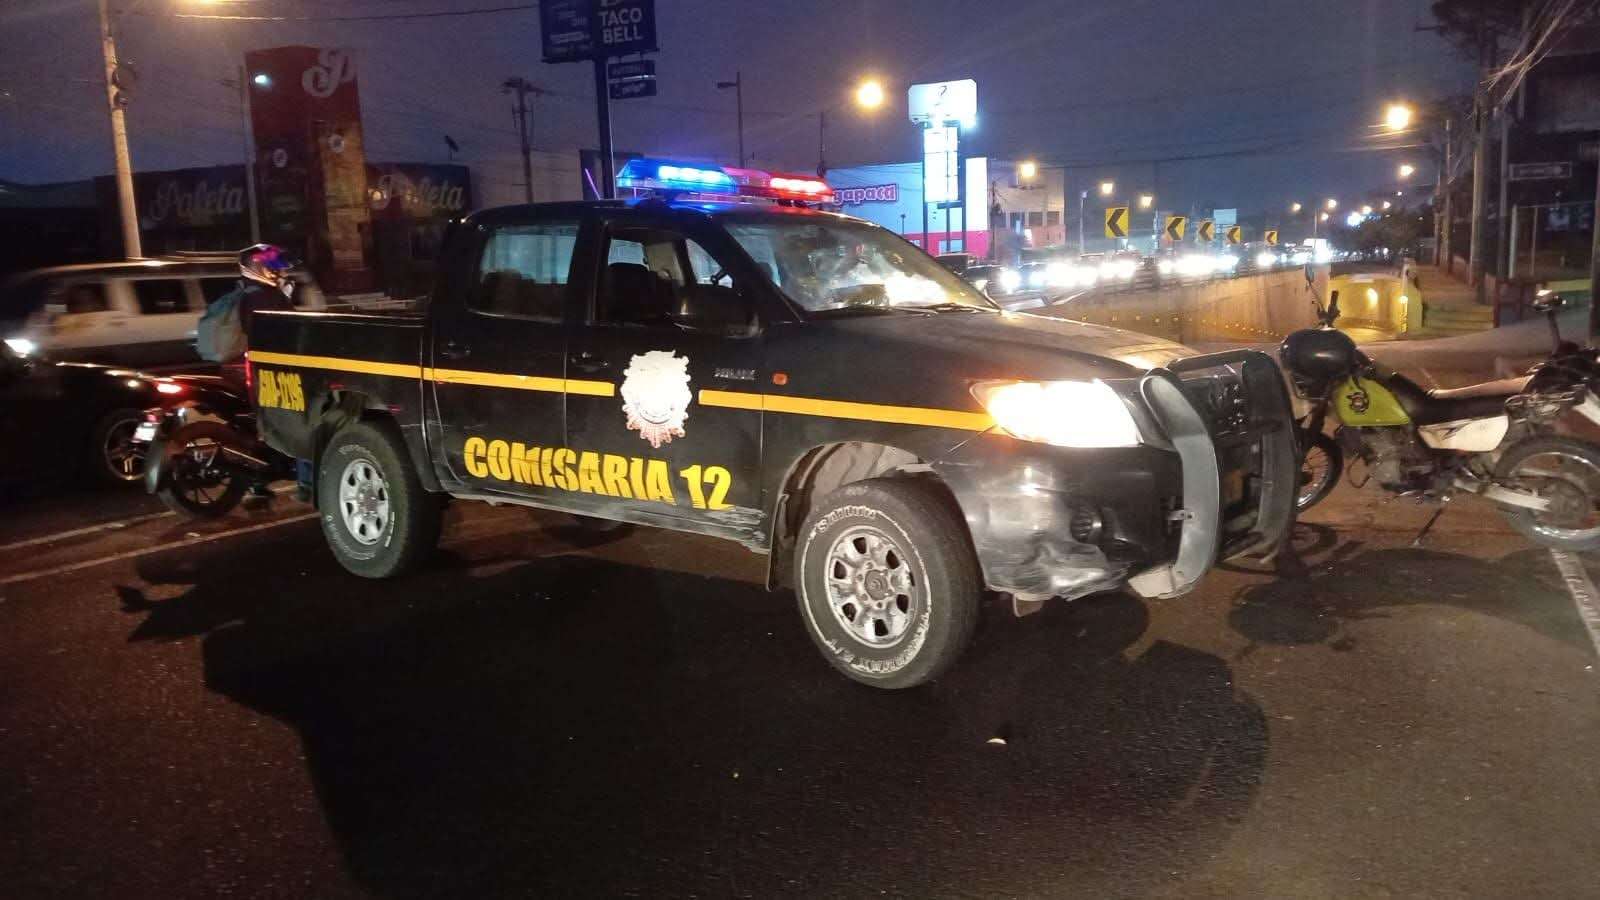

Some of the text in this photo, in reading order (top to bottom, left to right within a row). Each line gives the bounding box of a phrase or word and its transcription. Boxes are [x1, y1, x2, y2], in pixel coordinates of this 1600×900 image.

[597, 8, 642, 26] TACO
[602, 26, 644, 44] BELL
[463, 437, 736, 511] COMISARIA 12
